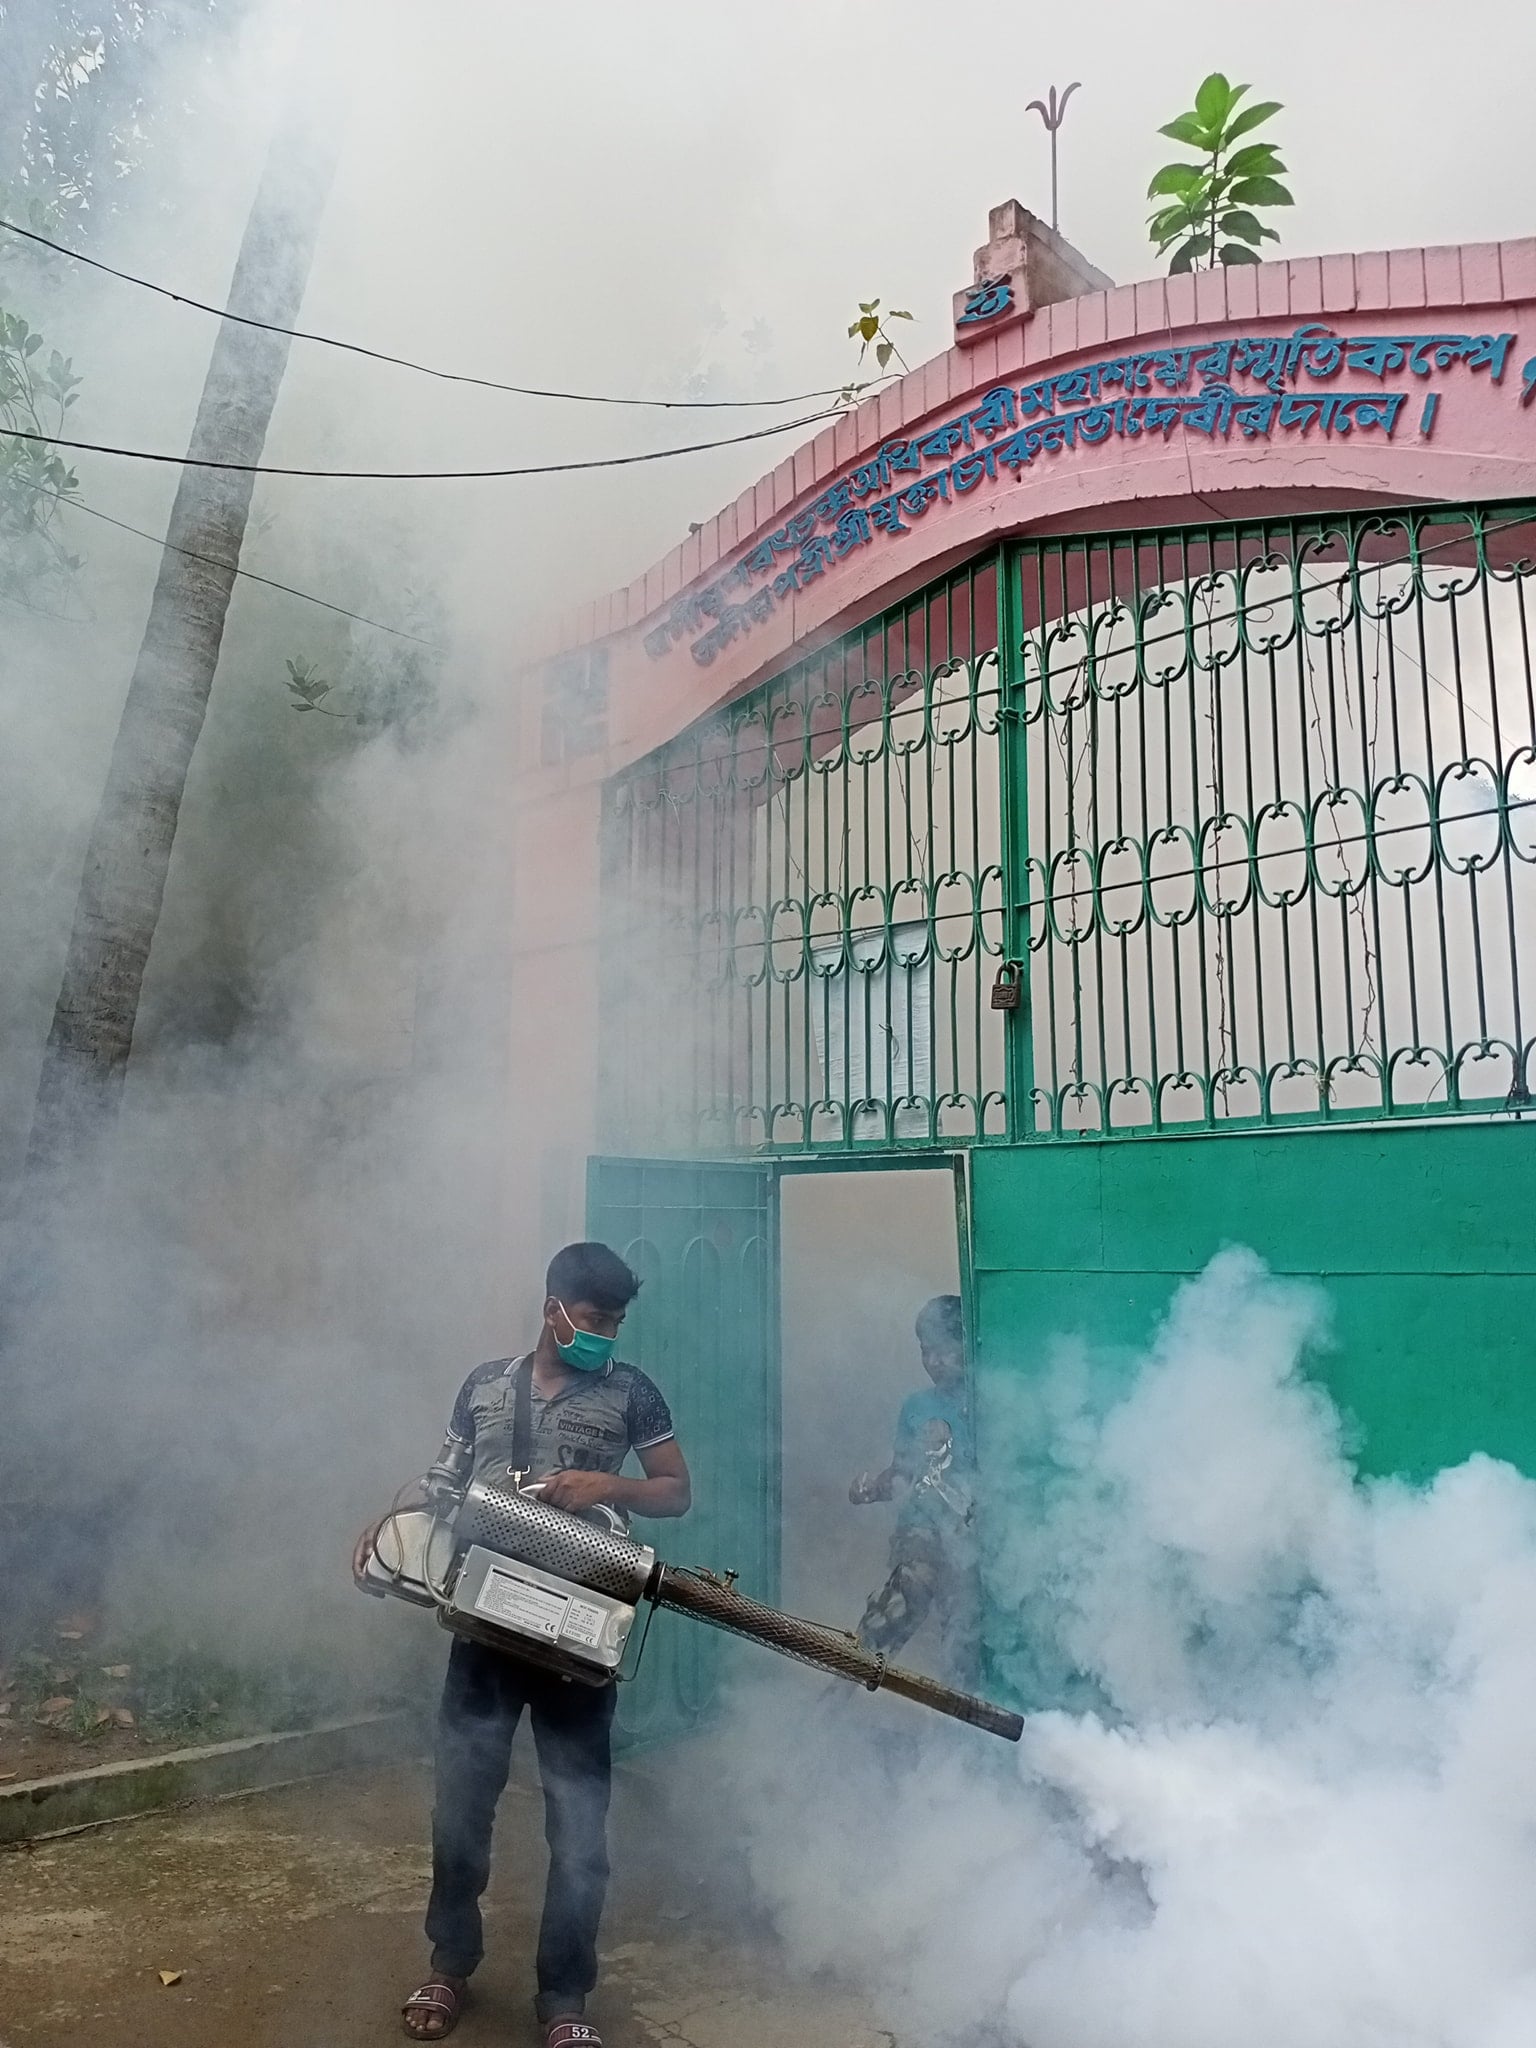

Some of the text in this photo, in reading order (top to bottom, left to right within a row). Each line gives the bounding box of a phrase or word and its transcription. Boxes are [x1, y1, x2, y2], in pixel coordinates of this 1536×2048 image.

[1280, 393, 1405, 433] দানে
[849, 386, 1016, 497] অধিকারী
[559, 1421, 600, 1437] VINTAGE
[571, 2026, 590, 2038] 52
